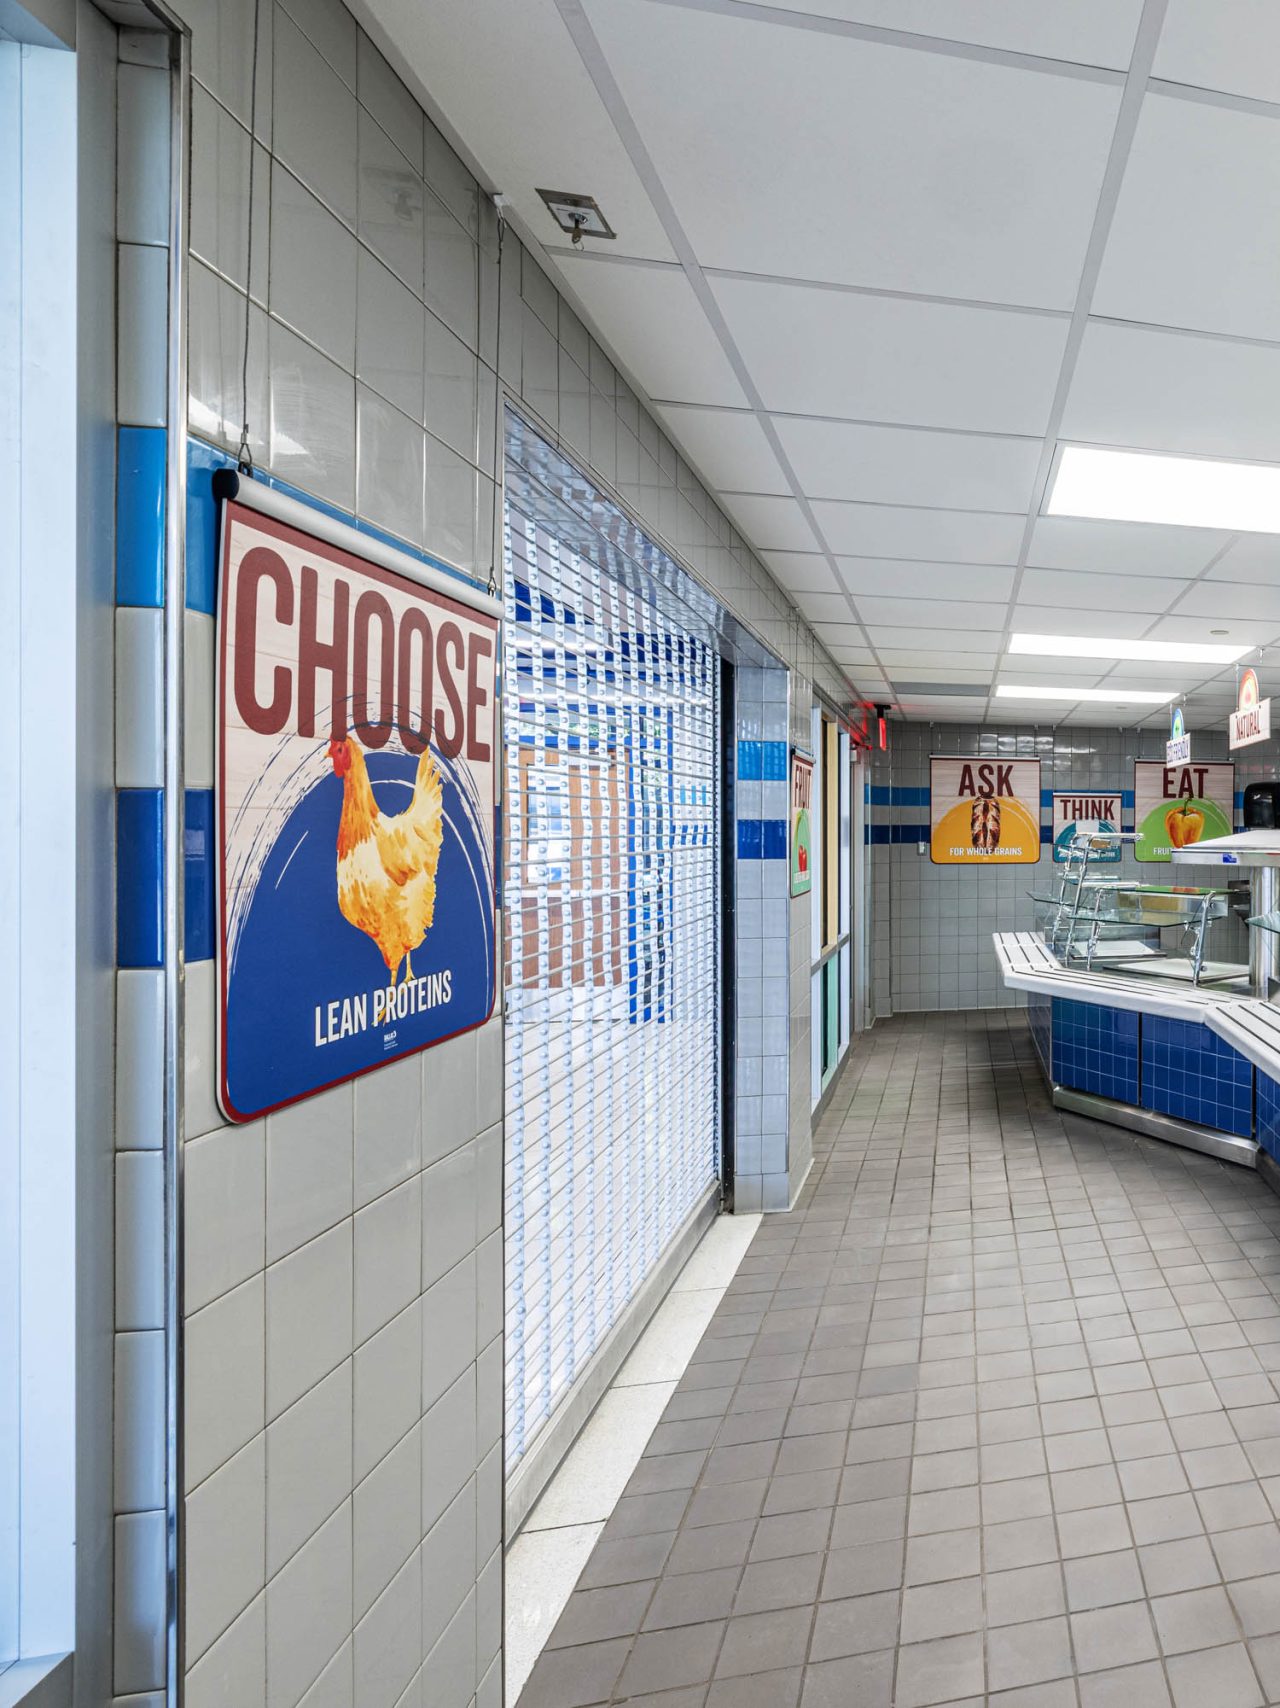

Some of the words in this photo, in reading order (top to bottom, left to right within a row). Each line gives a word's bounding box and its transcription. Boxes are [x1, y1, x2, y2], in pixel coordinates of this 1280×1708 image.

[234, 546, 492, 762] CHOOSE
[1237, 710, 1260, 741] NATURAL
[958, 764, 1014, 799] ASK
[1163, 768, 1209, 799] EAT
[1060, 799, 1115, 821] THINK
[949, 847, 964, 856] FOR
[966, 847, 993, 856] WHOLE
[994, 847, 1022, 856] GRAINS
[315, 993, 367, 1047] LEAN
[373, 969, 452, 1027] PROTEINS
